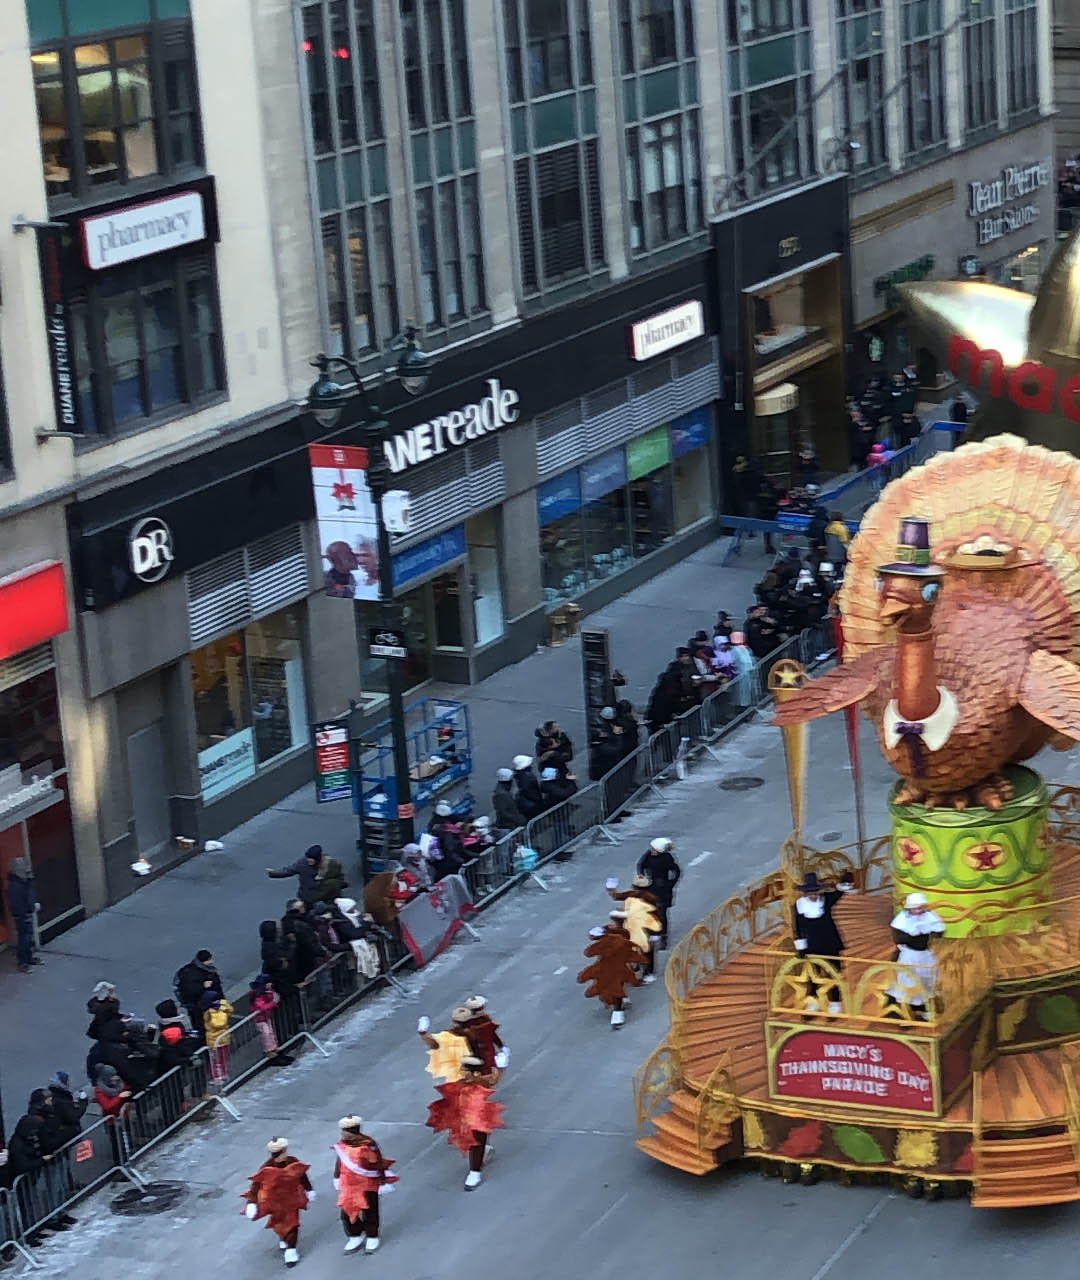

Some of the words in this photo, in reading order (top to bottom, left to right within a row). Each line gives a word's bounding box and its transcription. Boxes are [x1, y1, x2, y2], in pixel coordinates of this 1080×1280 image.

[97, 211, 191, 261] pharmacy
[823, 1043, 883, 1062] MACY'S
[779, 1060, 895, 1081] THANKSGIVING
[897, 1071, 930, 1092] DAY
[821, 1077, 889, 1097] PARADE
